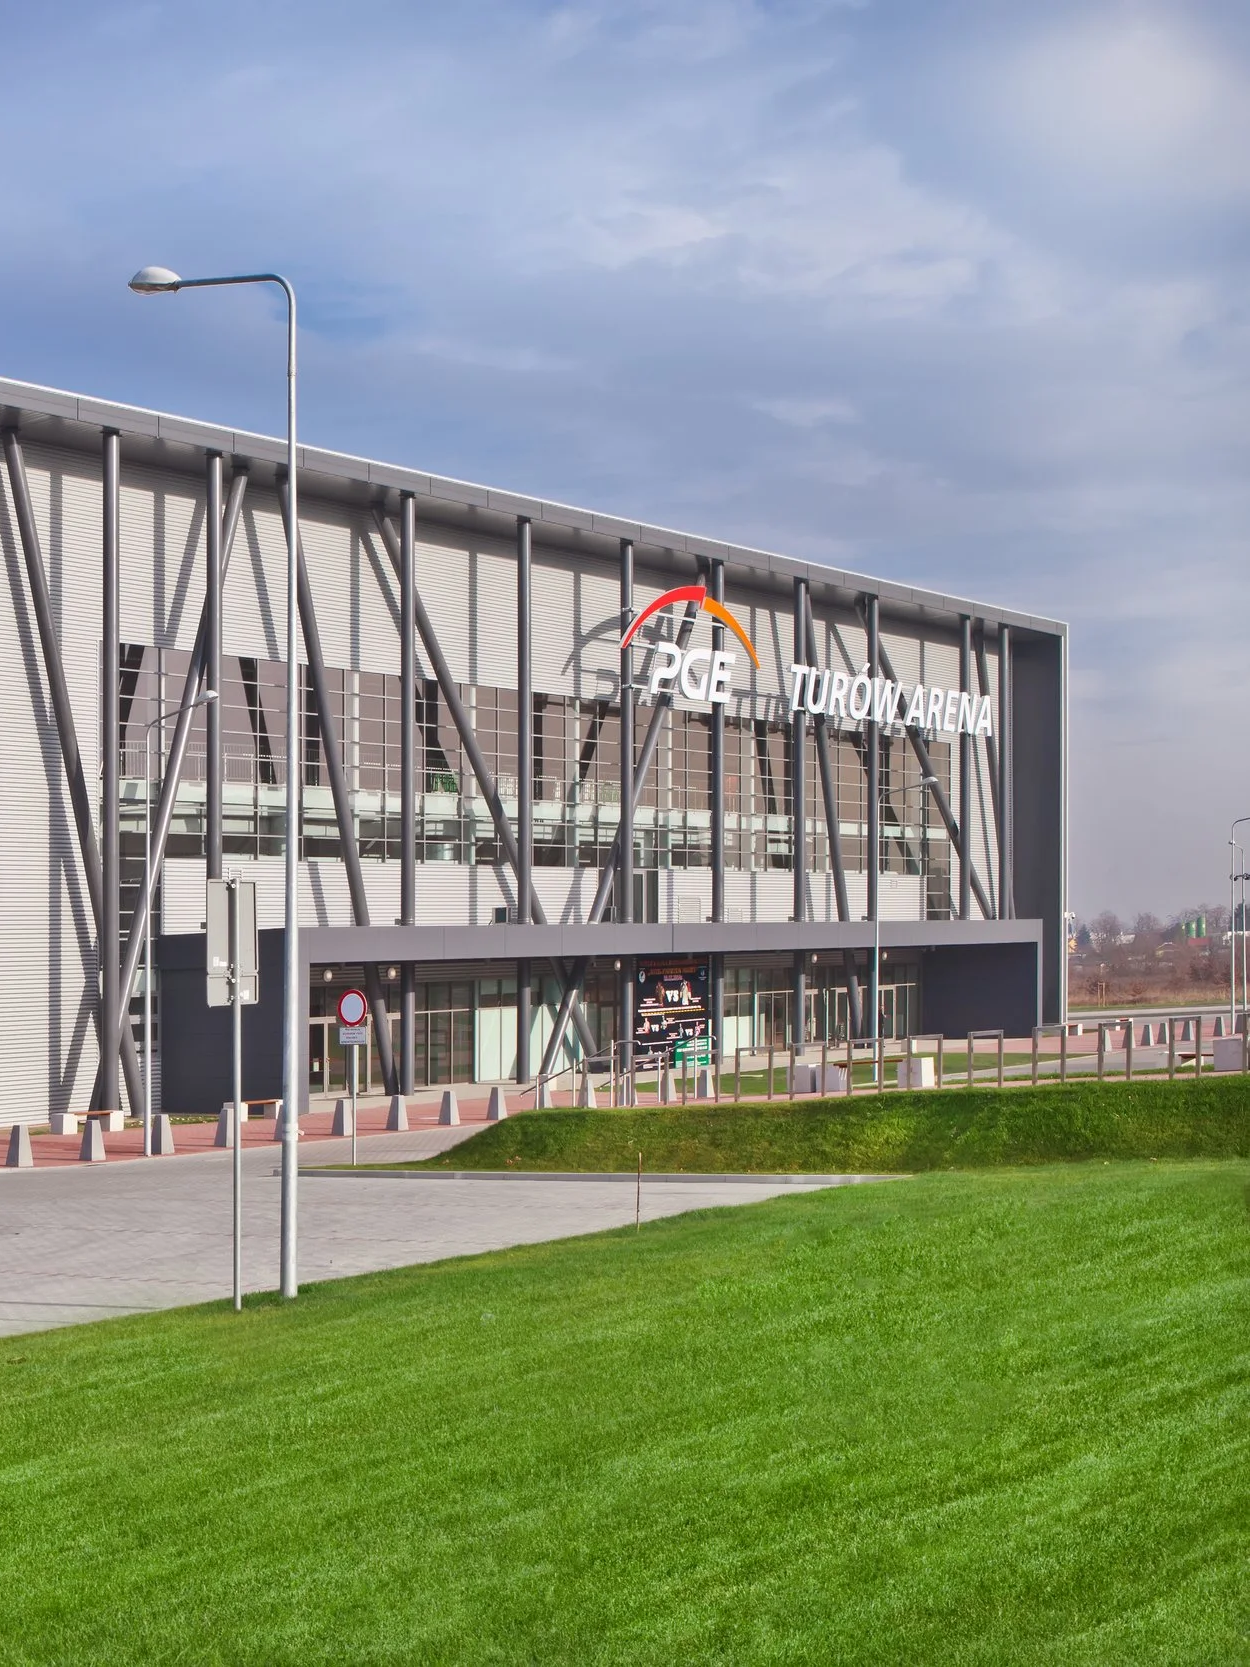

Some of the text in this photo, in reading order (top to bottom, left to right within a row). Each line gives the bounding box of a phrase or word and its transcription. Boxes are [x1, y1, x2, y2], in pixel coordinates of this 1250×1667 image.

[649, 641, 736, 703] PGE
[787, 662, 993, 737] TURÓW ARENA
[666, 989, 680, 1003] VS
